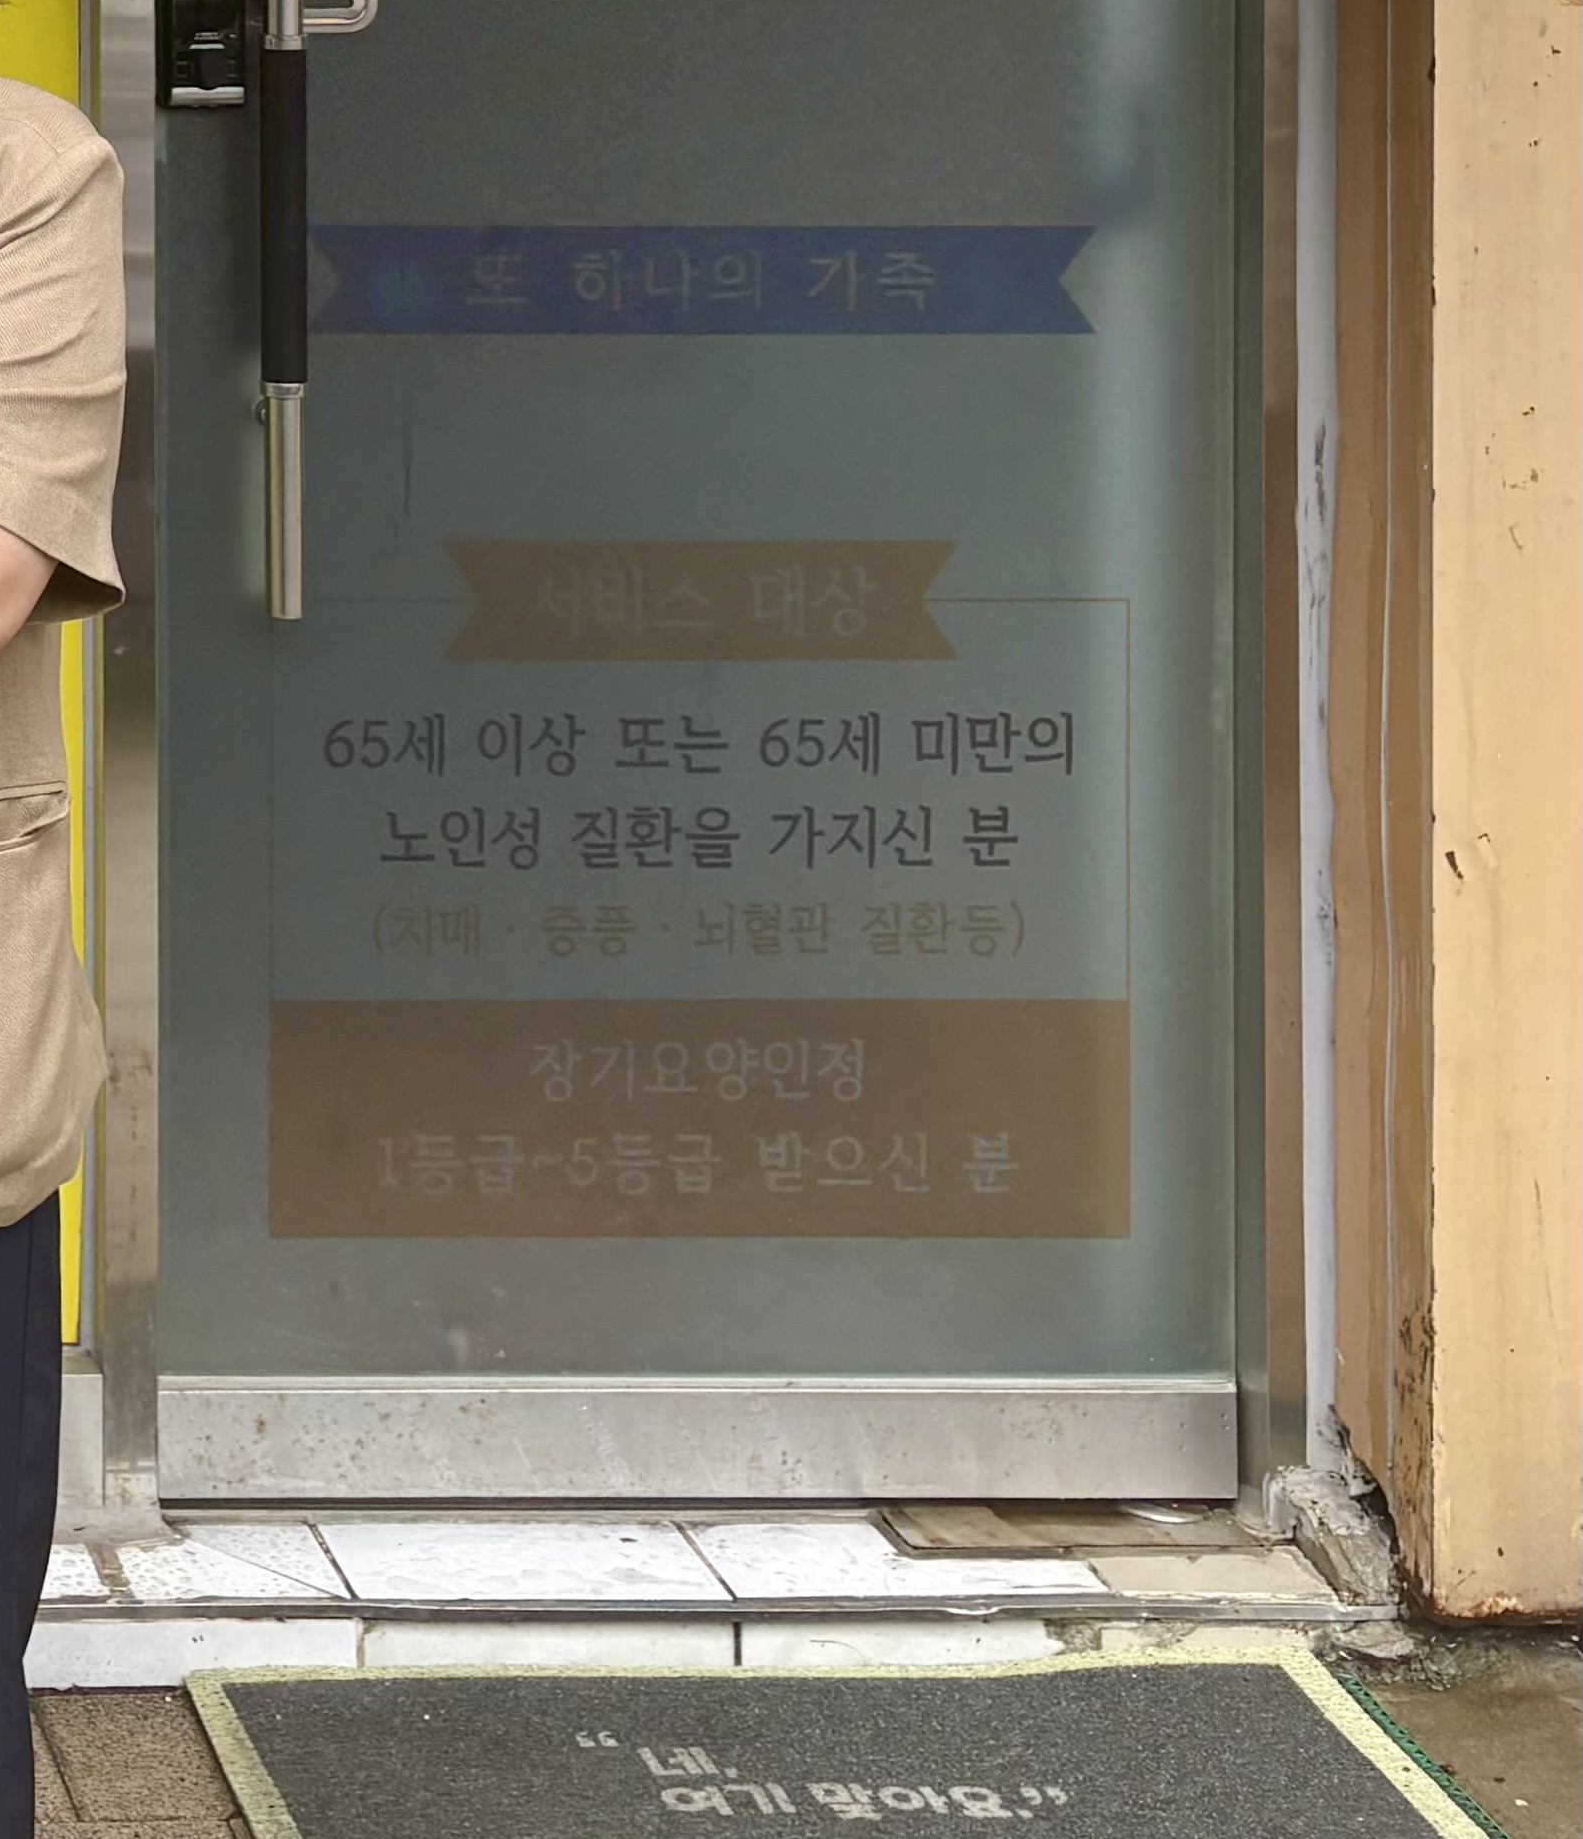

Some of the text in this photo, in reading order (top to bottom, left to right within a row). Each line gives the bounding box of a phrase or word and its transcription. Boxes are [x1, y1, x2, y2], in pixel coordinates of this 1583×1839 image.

[465, 248, 937, 314] 또 하나의 가족
[750, 563, 879, 641] 대상
[321, 711, 1077, 779] 65세 이상 또는 65세 미만의
[379, 806, 1021, 872] 노인성 질환을 가지신 분
[371, 901, 482, 959] (치매
[540, 903, 637, 959] 중풍
[693, 903, 833, 958] 뇌혈관
[860, 899, 1028, 959] 질환등)
[528, 1037, 868, 1104] 장기요양인정
[757, 1131, 932, 1196] 받으신
[960, 1132, 1022, 1196] 분
[659, 1782, 797, 1816] 여기
